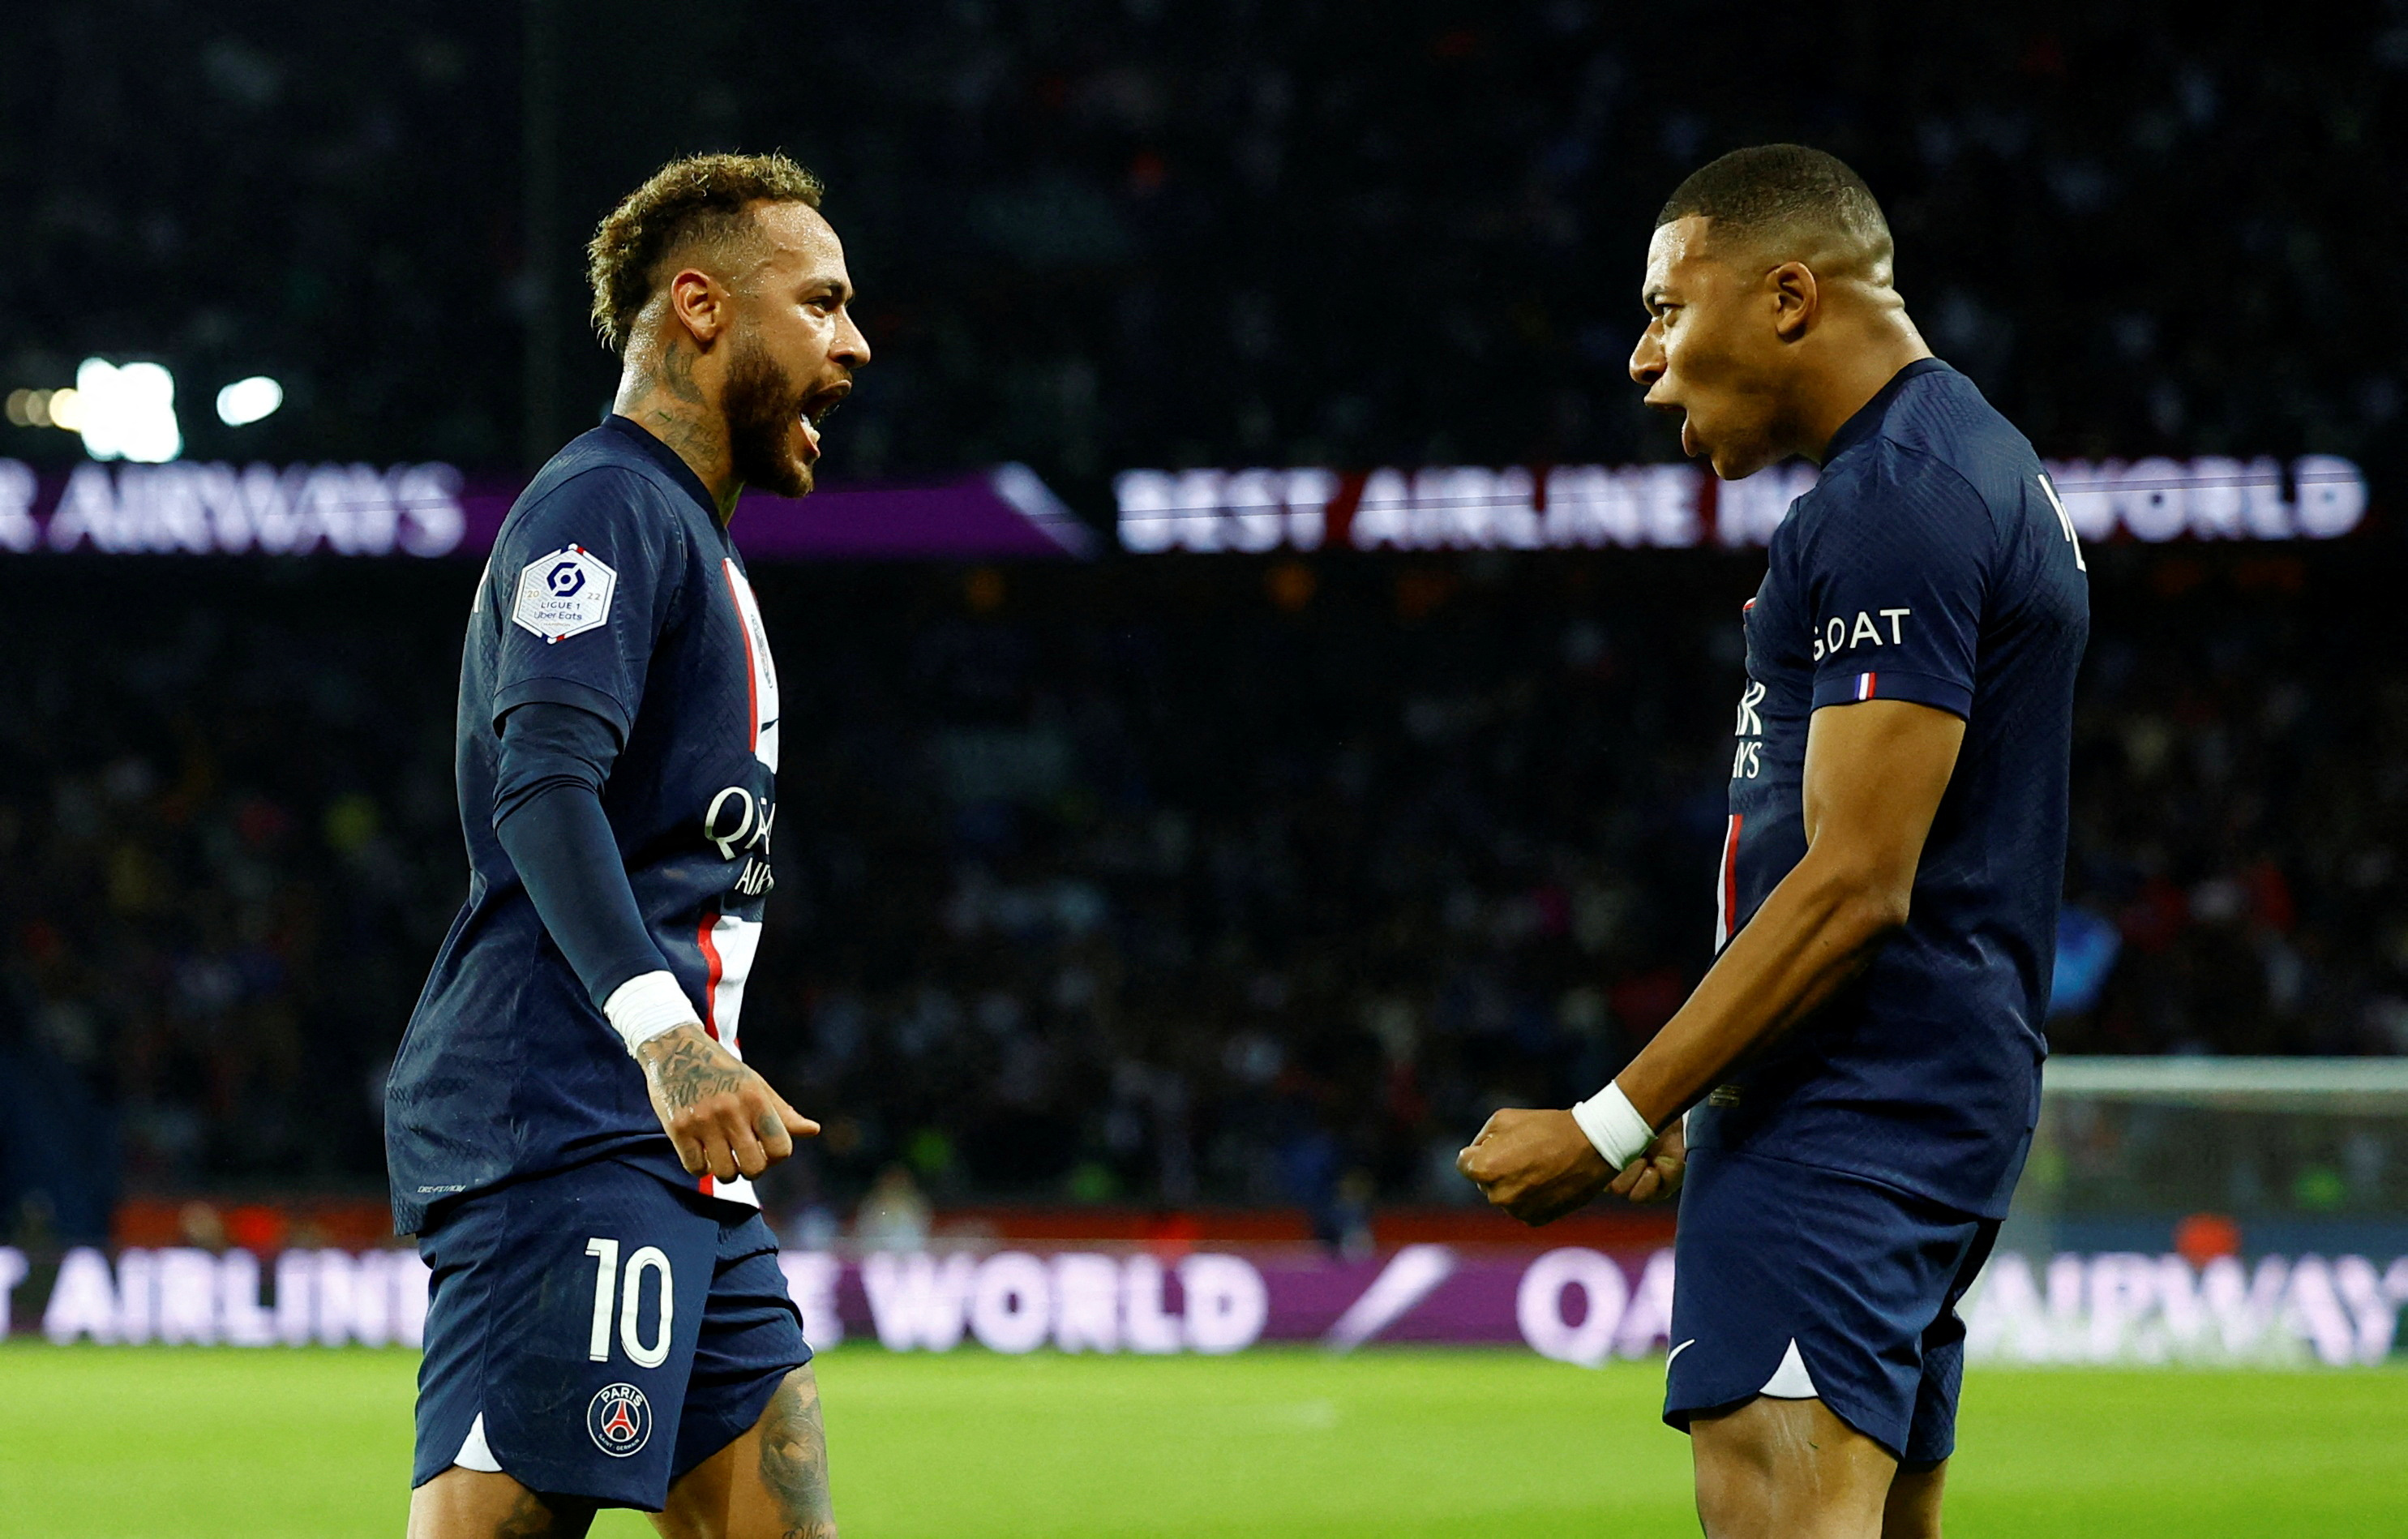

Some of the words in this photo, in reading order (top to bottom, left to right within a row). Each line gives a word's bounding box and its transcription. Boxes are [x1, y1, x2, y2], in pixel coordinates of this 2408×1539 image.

[45, 460, 465, 556] AIRWAYS
[1116, 468, 1330, 554] BEST
[1349, 464, 1704, 551] AIRLINE
[534, 611, 557, 619] Uber
[559, 611, 582, 620] Eats
[587, 592, 601, 600] 22
[585, 1237, 673, 1368] 10
[862, 1251, 1268, 1355] WORLD
[1964, 1250, 2408, 1365] AIRWAY
[601, 1387, 643, 1407] PARIS
